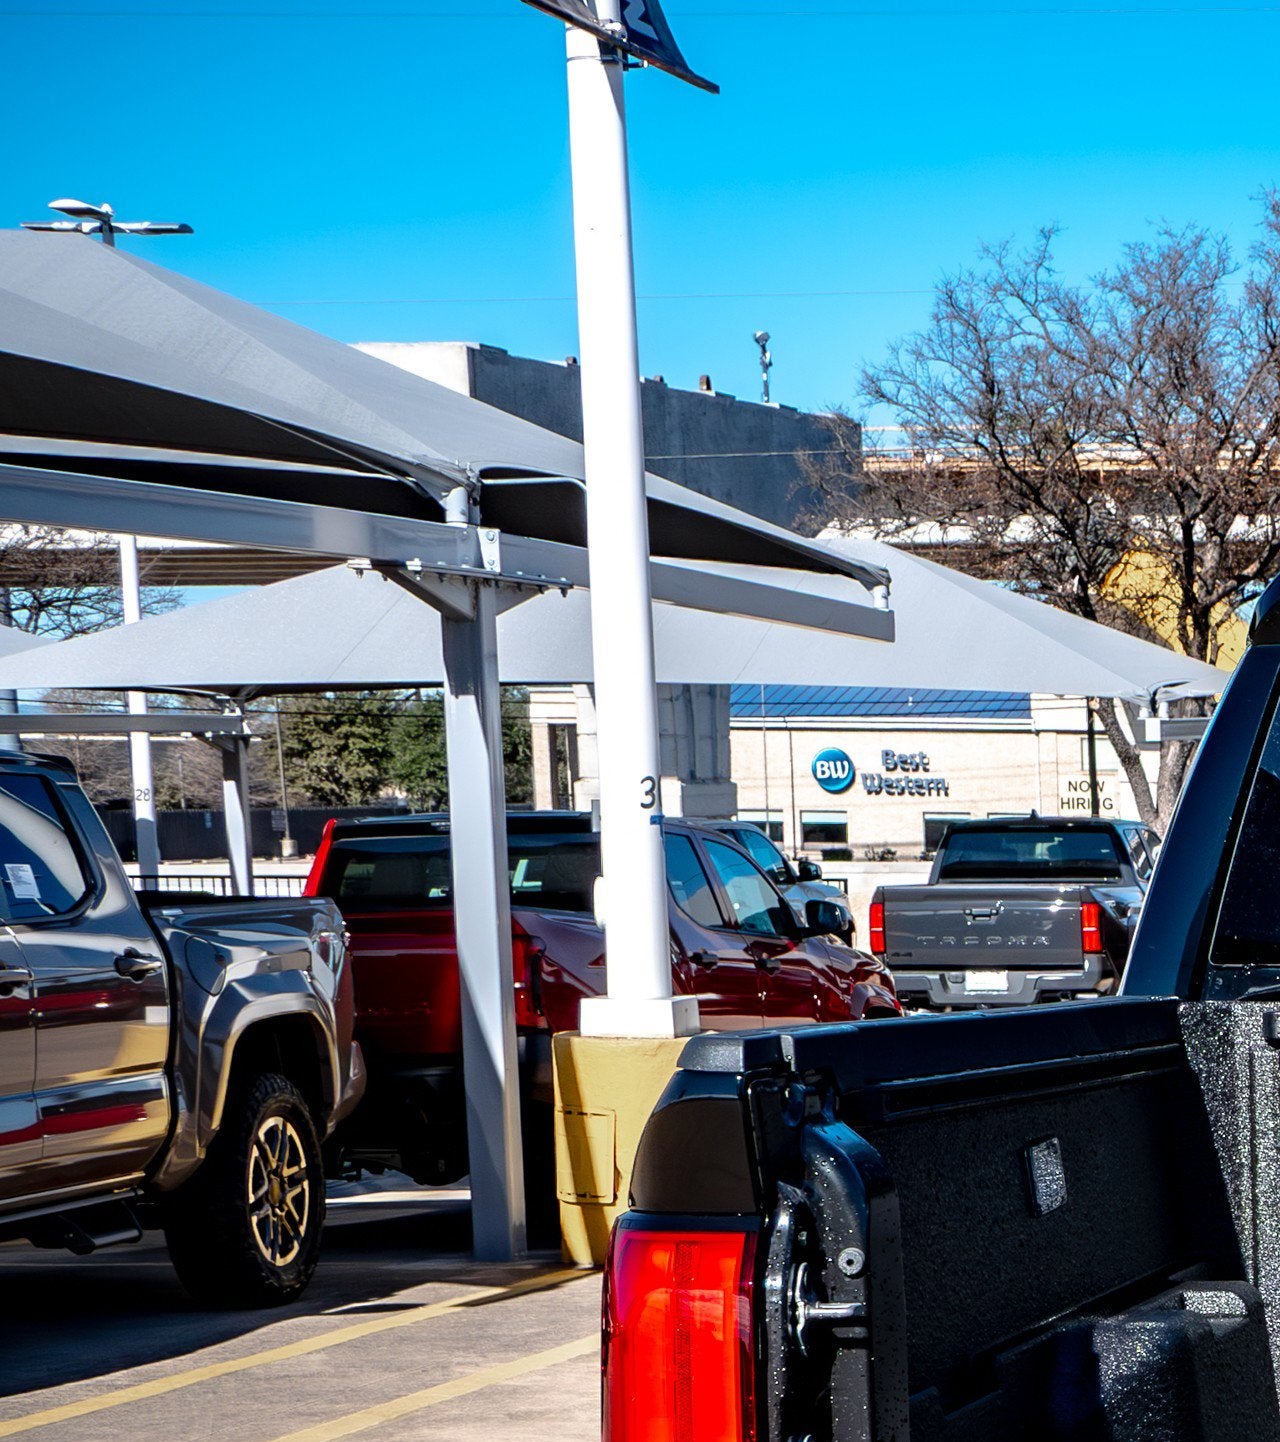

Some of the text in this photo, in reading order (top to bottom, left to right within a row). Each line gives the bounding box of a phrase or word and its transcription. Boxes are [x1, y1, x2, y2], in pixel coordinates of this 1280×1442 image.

[881, 749, 929, 771] Best
[816, 760, 849, 779] BW
[861, 773, 949, 796] Western
[1068, 780, 1105, 792] NOW
[136, 788, 150, 801] 28
[1061, 797, 1114, 810] HIRIG
